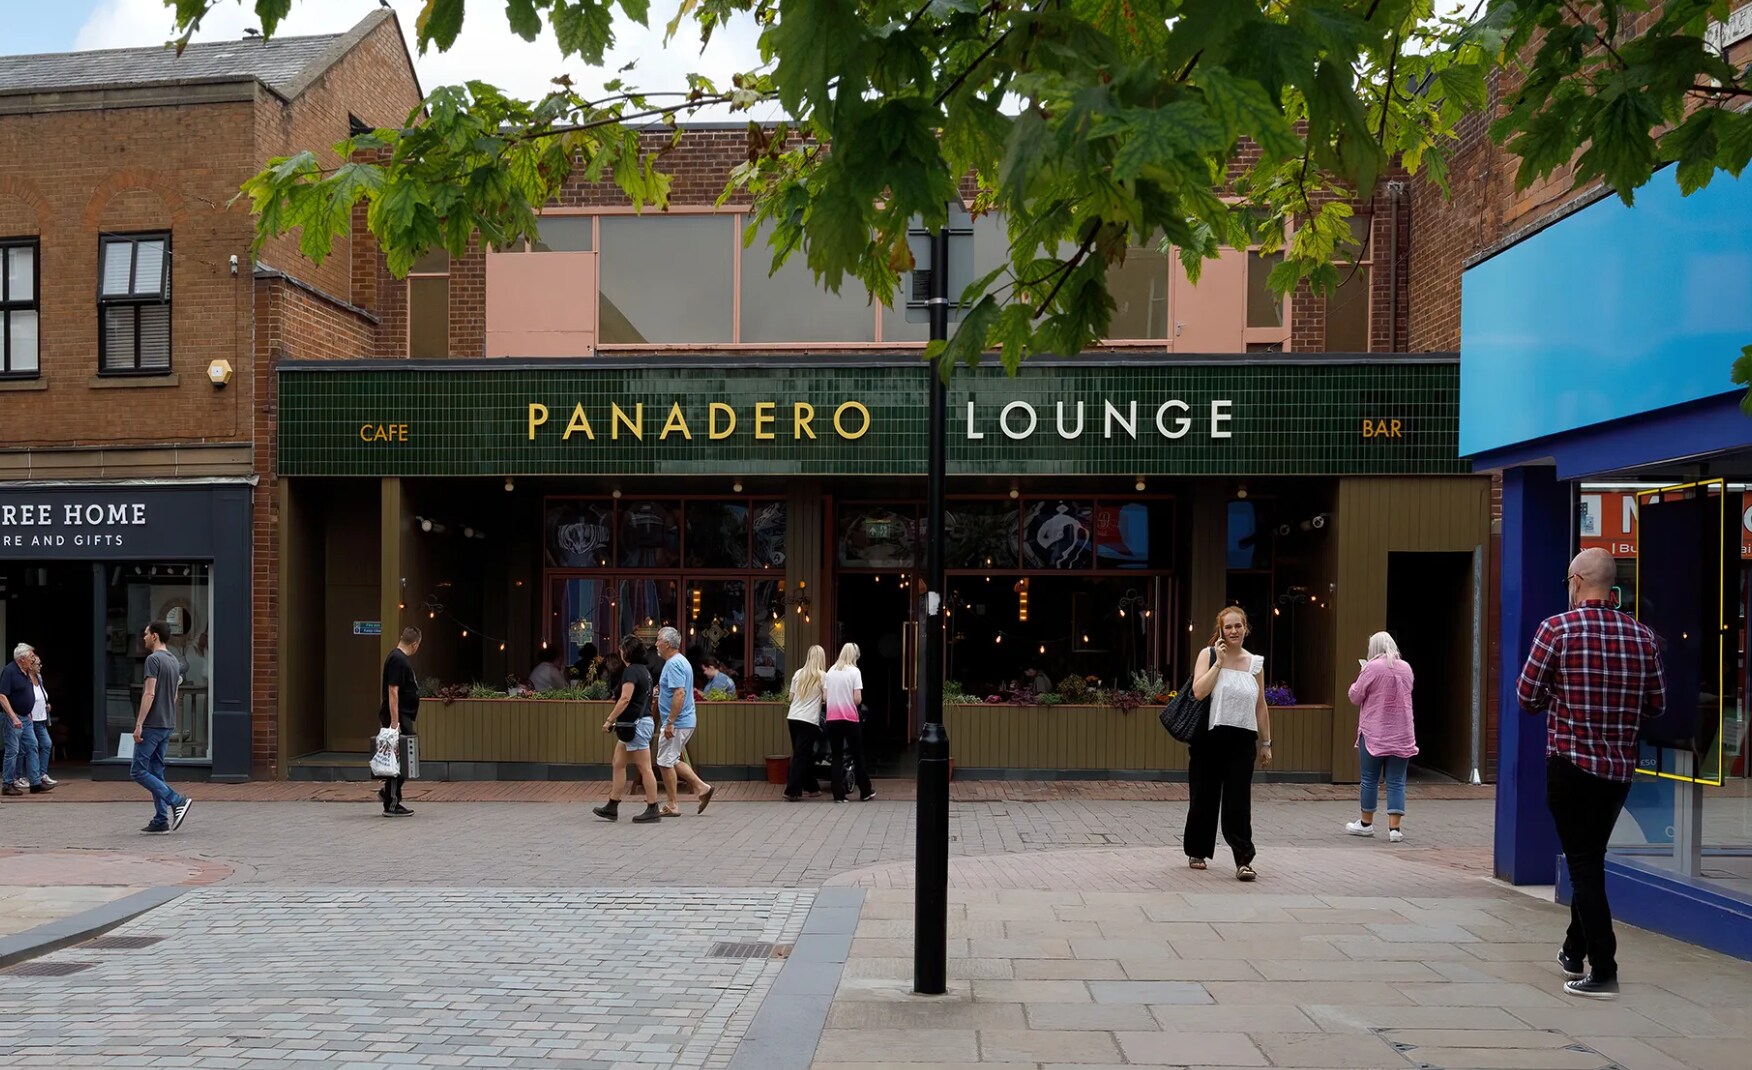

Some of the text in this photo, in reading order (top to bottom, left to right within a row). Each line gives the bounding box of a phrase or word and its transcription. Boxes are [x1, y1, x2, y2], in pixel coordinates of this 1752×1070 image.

[527, 399, 1233, 440] PANADERO LOUNGE
[1362, 419, 1402, 438] BAR
[360, 424, 408, 442] CAFE
[1, 503, 146, 526] REE HOME
[3, 534, 124, 546] RE AND GIFTS
